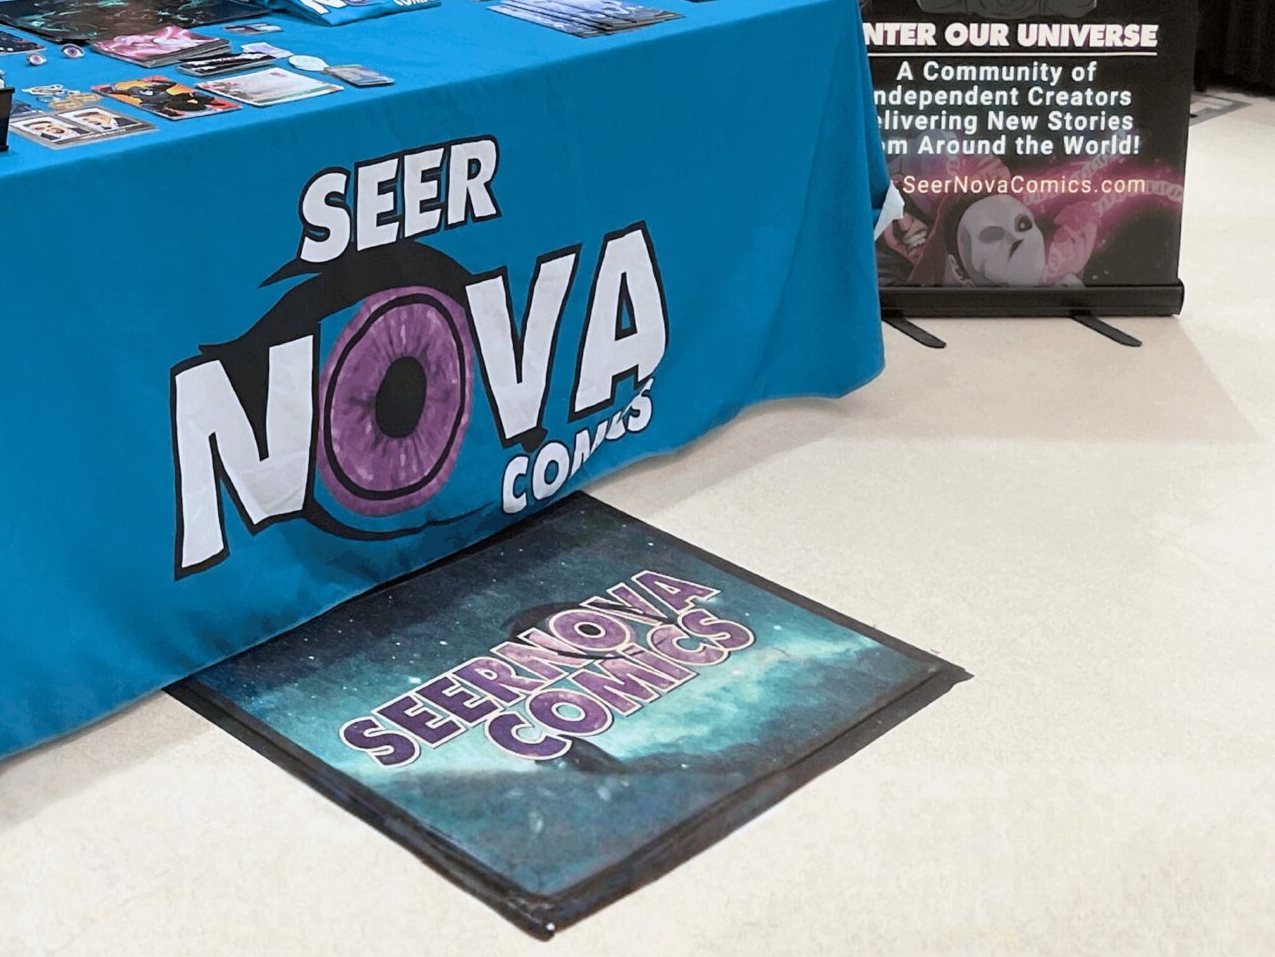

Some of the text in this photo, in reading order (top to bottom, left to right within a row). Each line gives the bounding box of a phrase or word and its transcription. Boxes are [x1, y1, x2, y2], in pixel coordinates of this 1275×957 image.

[863, 22, 1159, 48] NTER OUR UNIVERSE
[896, 60, 1098, 86] A Community of
[873, 84, 1132, 111] ndependent Creators
[987, 111, 1039, 131] New
[1047, 111, 1134, 132] Stories
[917, 134, 1007, 155] Around
[1015, 134, 1054, 155] the
[1062, 134, 1141, 156] World!
[902, 175, 1146, 195] SeerNovaComics.com
[298, 137, 501, 265] SEER
[172, 226, 668, 573] NOVA
[338, 569, 721, 769] SEERNOVA
[482, 608, 756, 762] COMICS
